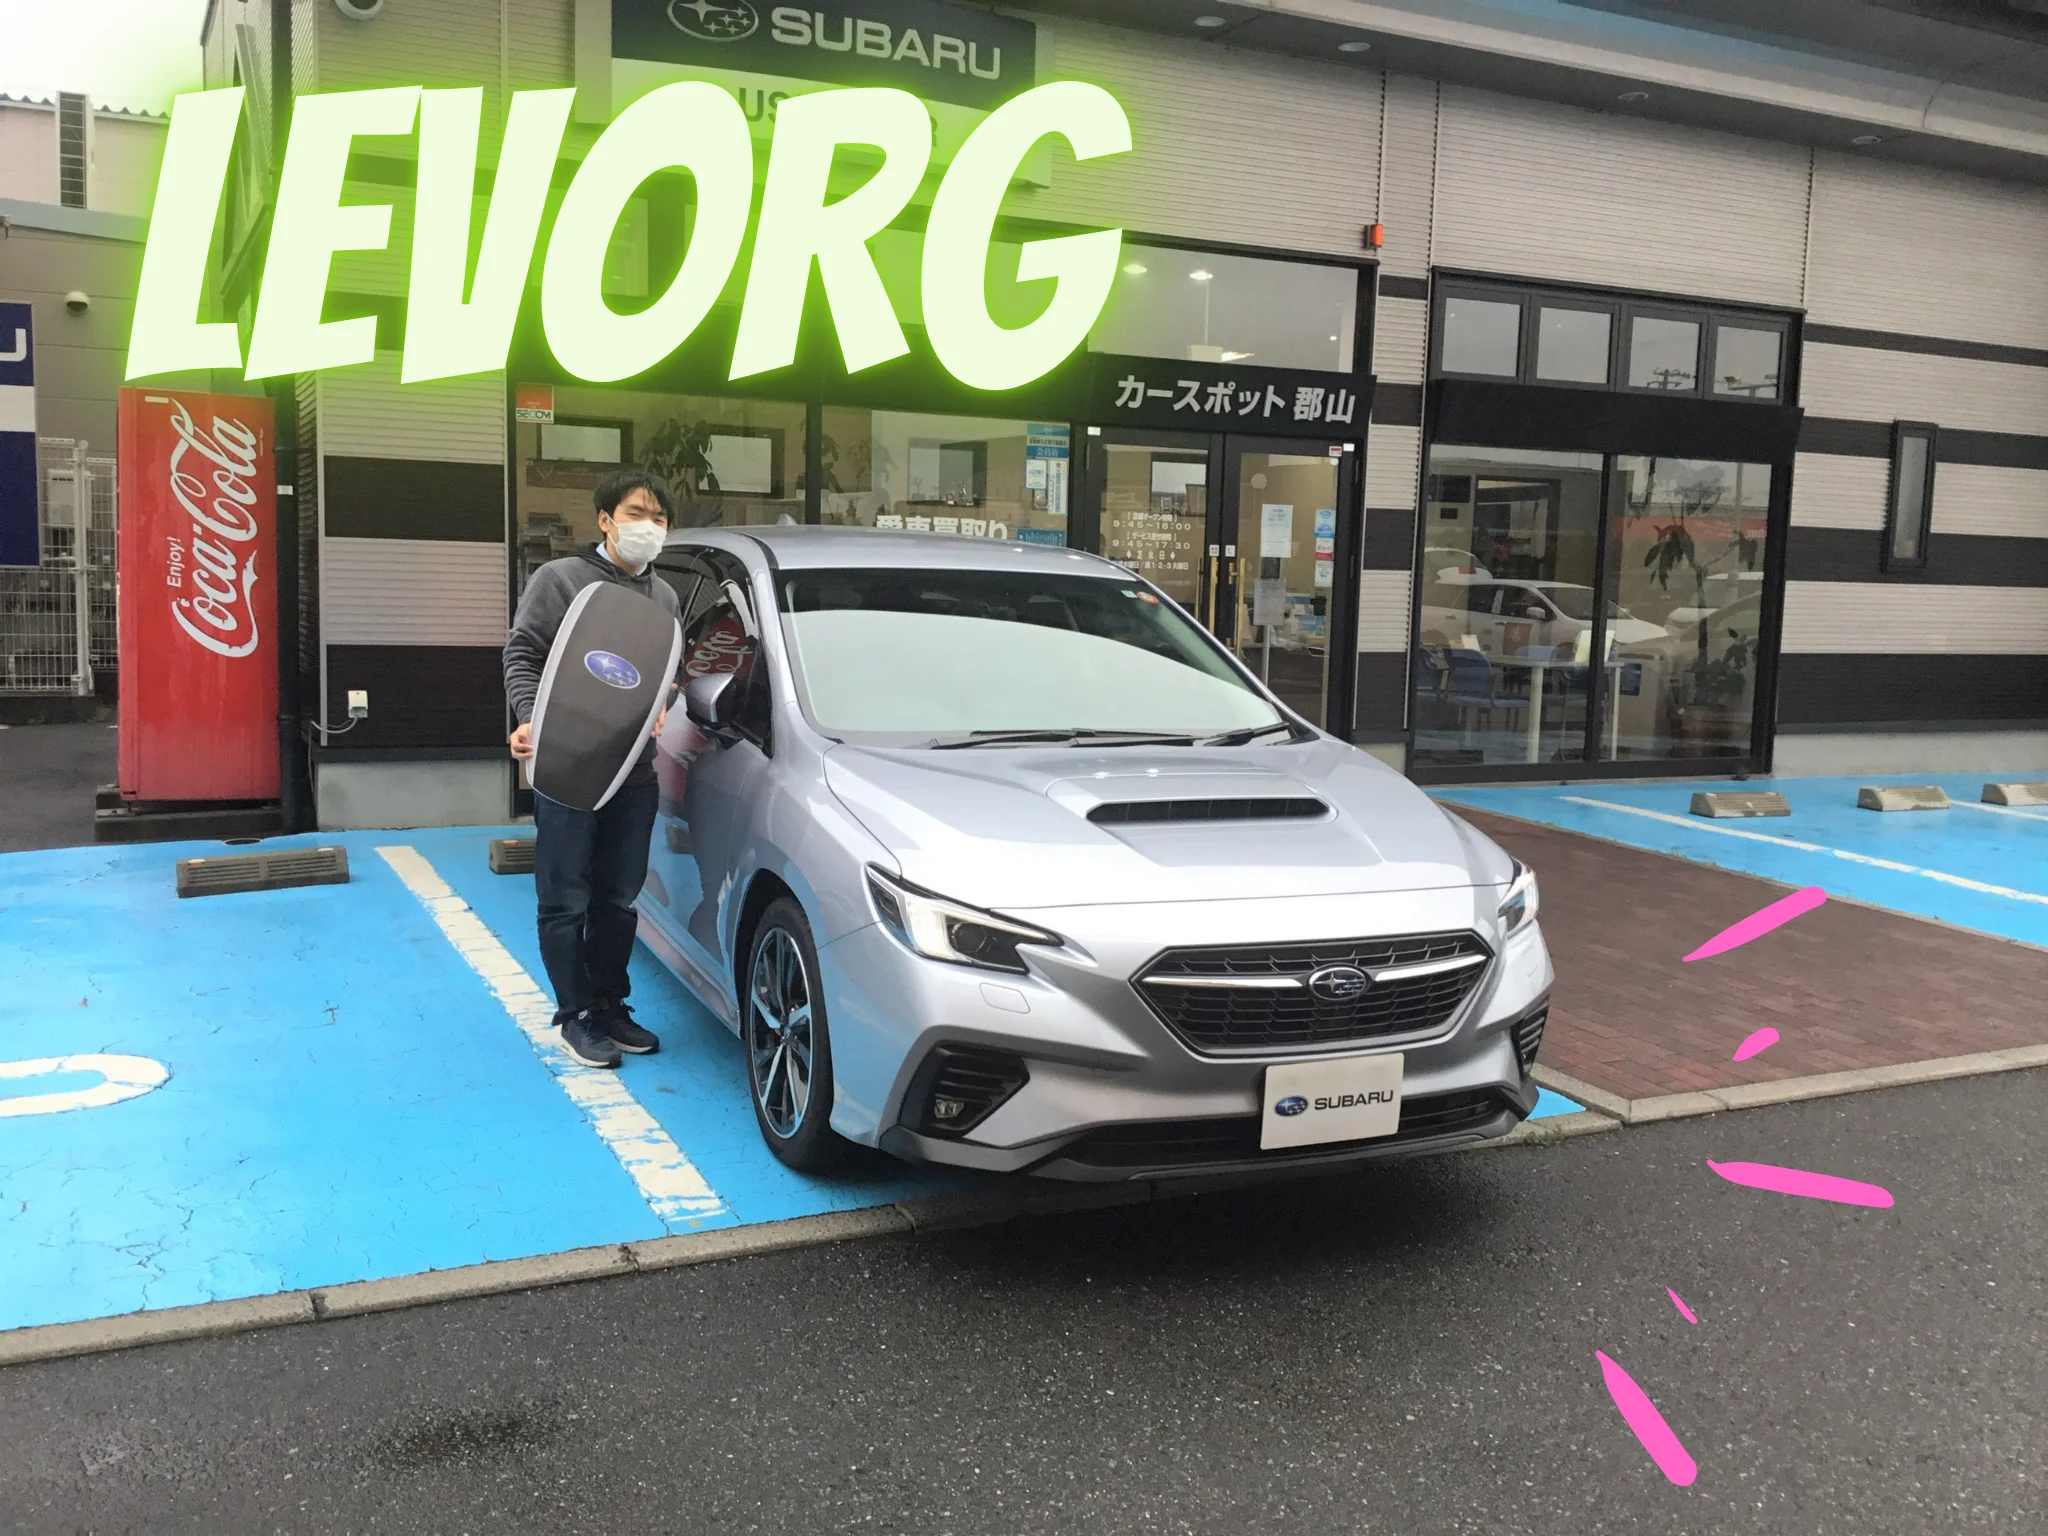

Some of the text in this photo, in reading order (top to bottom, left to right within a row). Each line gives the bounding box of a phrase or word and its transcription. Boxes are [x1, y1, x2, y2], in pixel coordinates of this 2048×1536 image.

[771, 7, 1001, 80] SUBARU
[516, 409, 551, 420] SECOM
[1114, 374, 1356, 424] カースポット 郡山
[166, 537, 185, 588] Enjoy!
[1314, 1090, 1394, 1111] SUBARU
